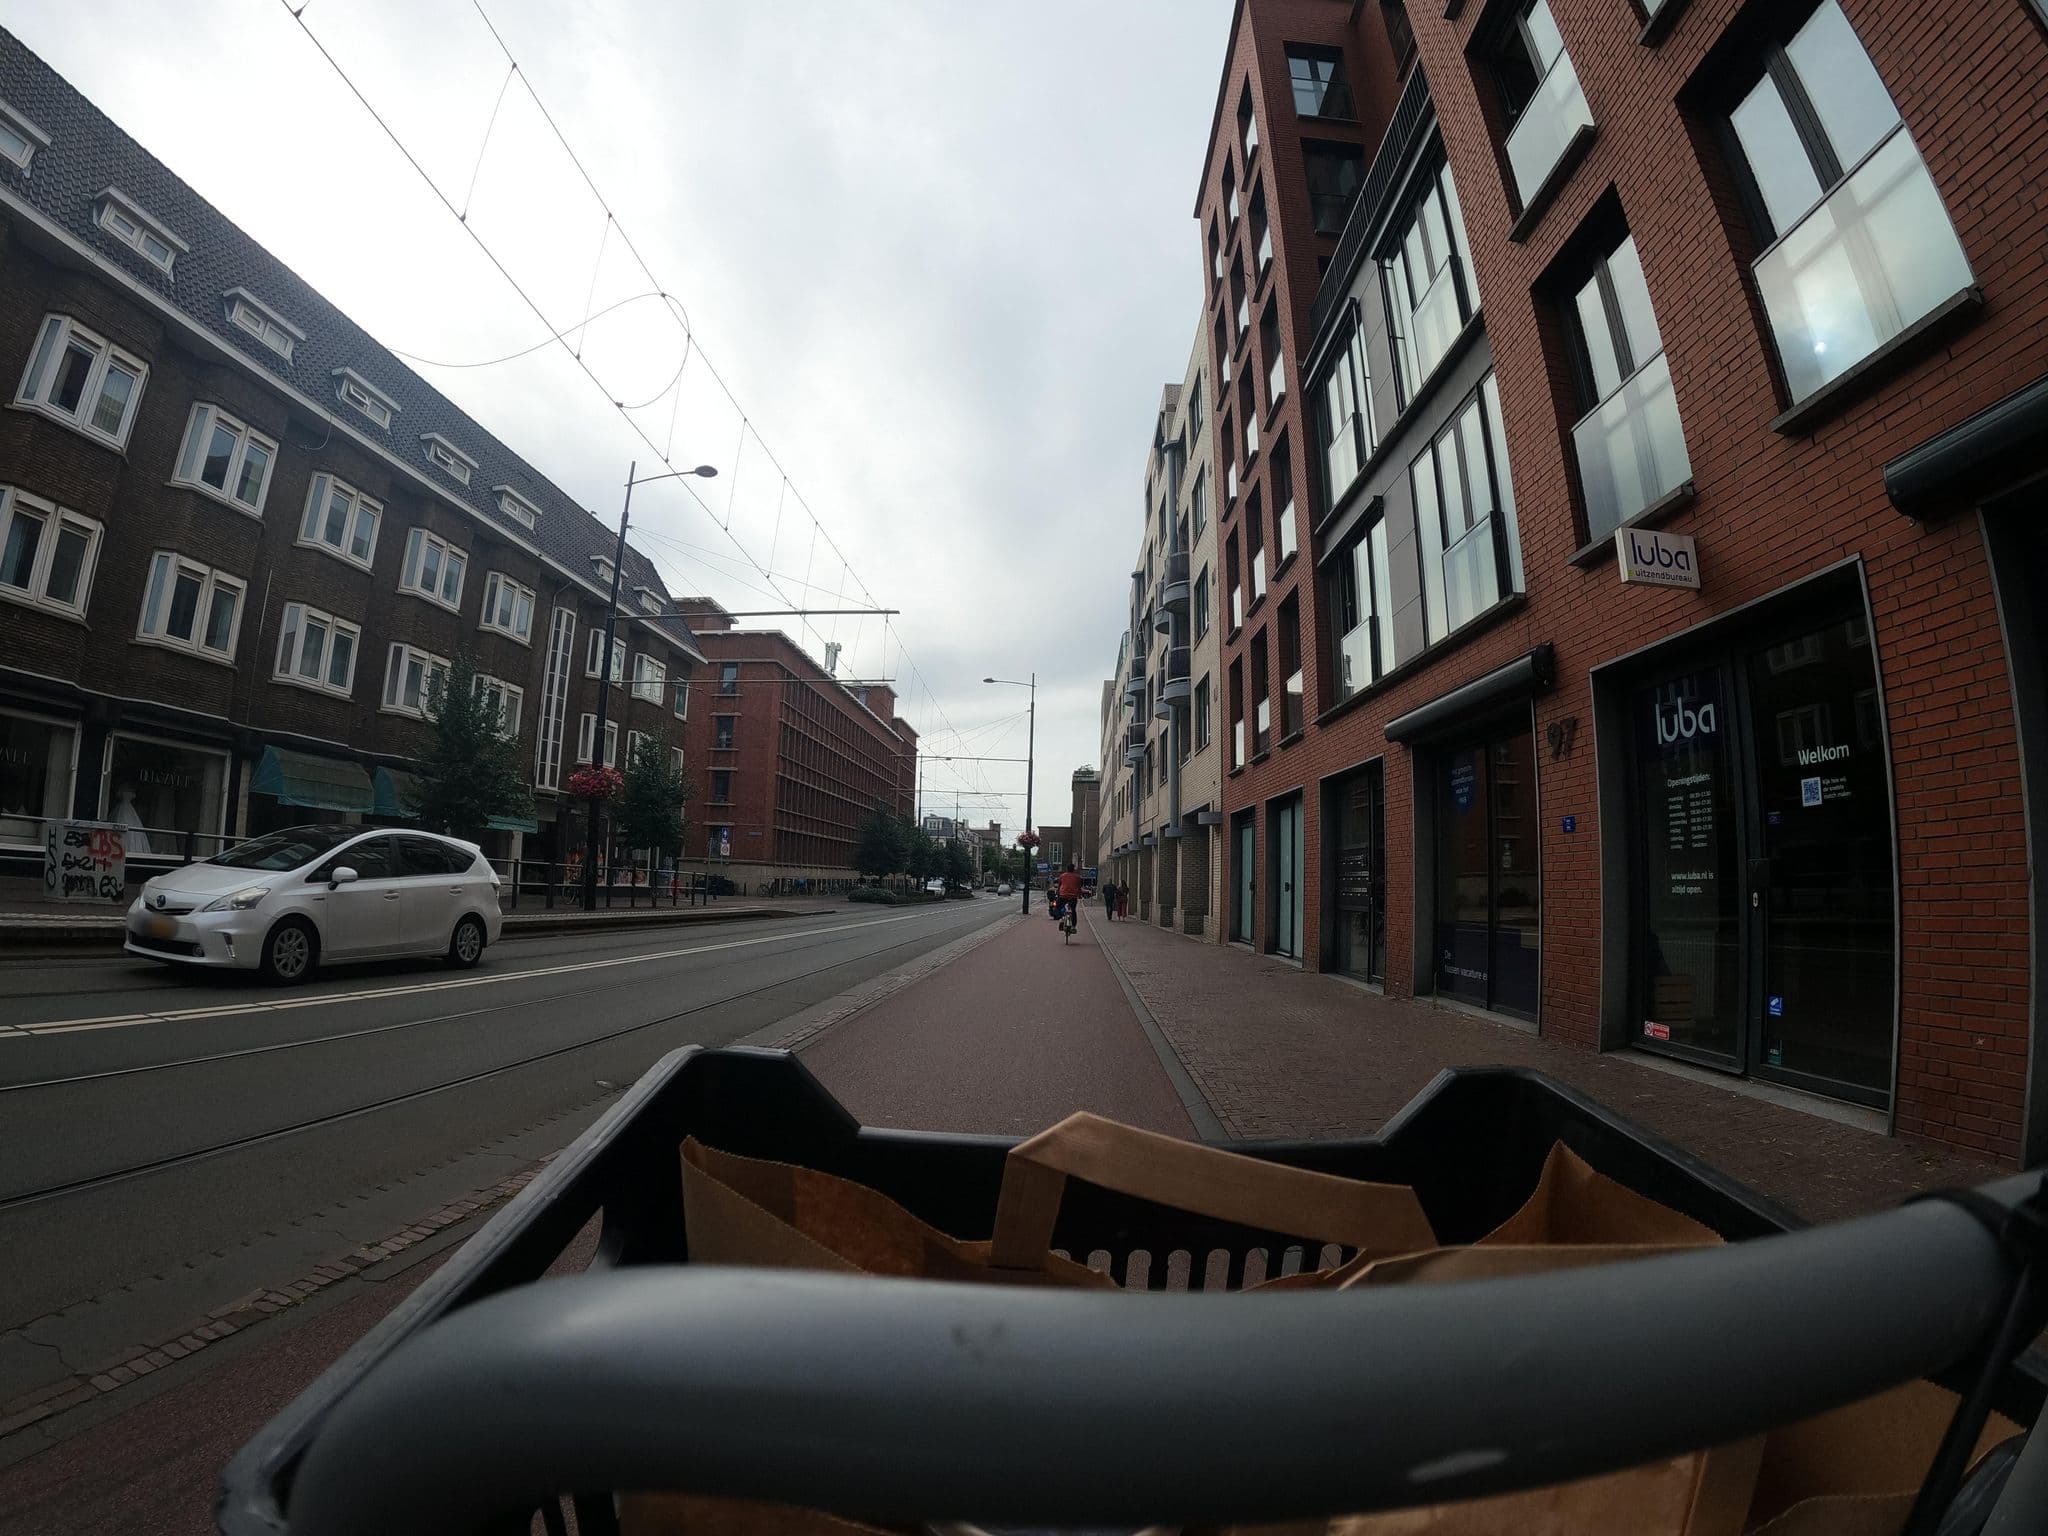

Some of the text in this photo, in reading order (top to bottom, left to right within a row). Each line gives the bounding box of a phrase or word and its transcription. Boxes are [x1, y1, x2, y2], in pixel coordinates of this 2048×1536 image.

[1631, 533, 1690, 570] luba
[1635, 569, 1692, 582] uitzendbureau
[1655, 697, 1716, 745] luba
[1797, 744, 1850, 766] Welkom
[1671, 871, 1708, 881] www.luba.nl
